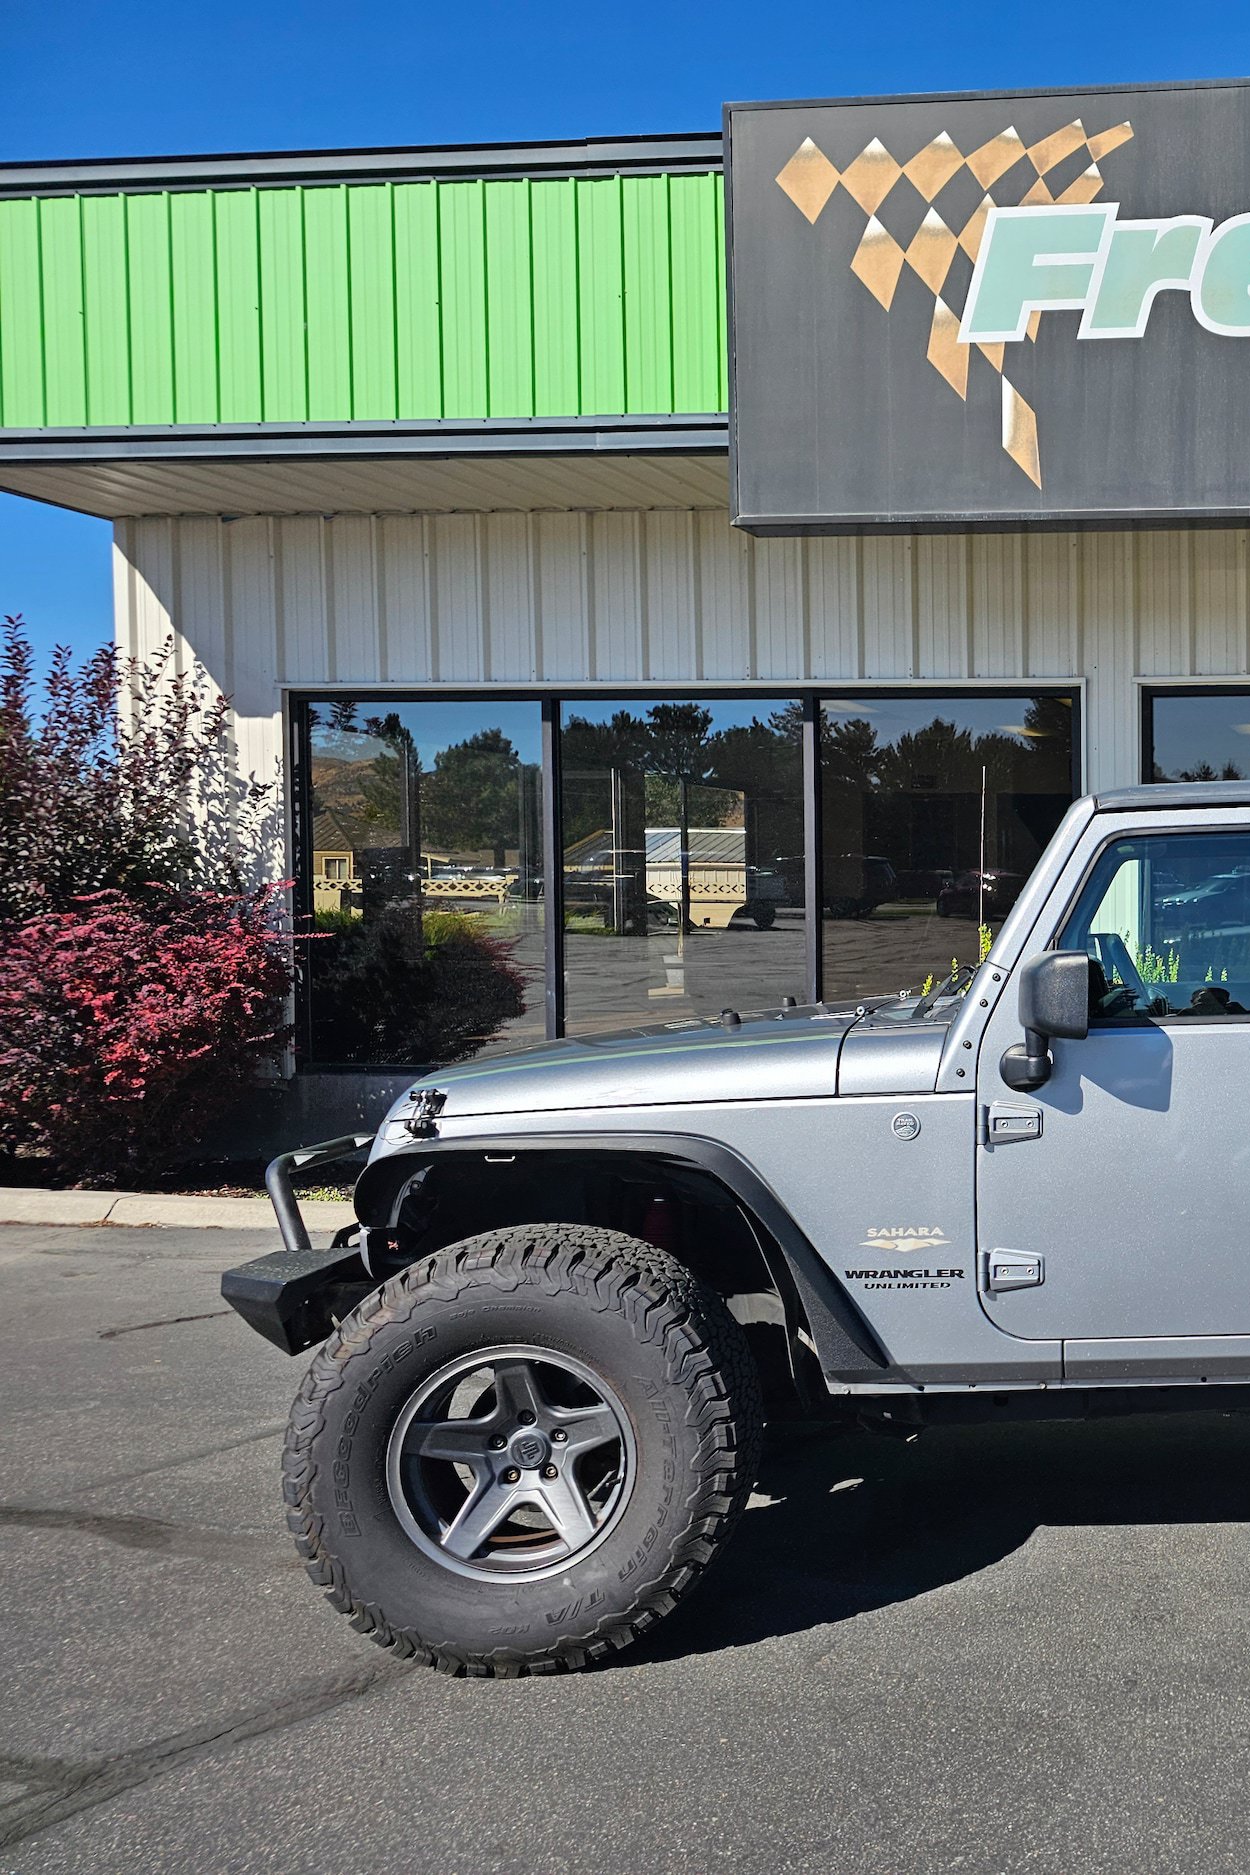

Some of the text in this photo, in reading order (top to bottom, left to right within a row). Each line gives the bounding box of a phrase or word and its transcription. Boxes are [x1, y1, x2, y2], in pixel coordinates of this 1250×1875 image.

[867, 1226, 944, 1238] SAHARA
[844, 1269, 965, 1279] WRANGLER
[864, 1282, 951, 1290] UNLIMITED
[481, 1304, 544, 1314] Champion
[333, 1324, 438, 1538] BFGoodrich
[618, 1374, 679, 1584] All-Terrain
